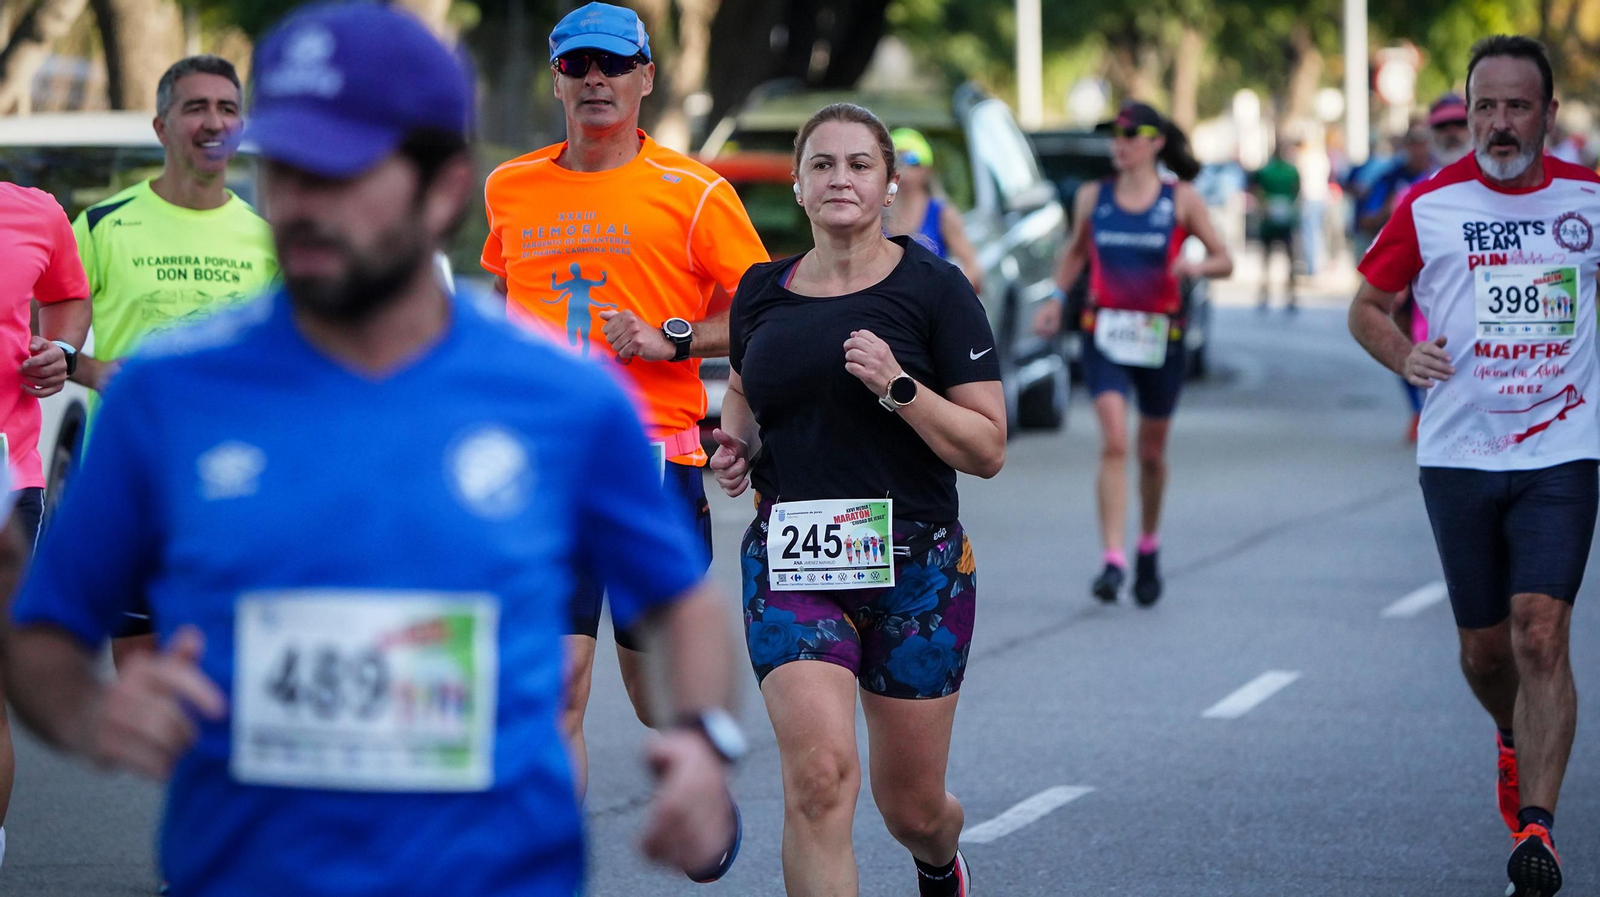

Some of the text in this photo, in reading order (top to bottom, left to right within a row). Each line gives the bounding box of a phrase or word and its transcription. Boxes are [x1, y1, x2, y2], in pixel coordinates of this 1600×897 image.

[557, 211, 596, 221] XXXIII
[522, 223, 631, 239] MEMORIAL
[1462, 220, 1546, 236] SPORTS
[522, 236, 631, 250] SARGENTO DE INFANTERIA
[1464, 232, 1522, 252] TEAM
[522, 251, 530, 259] DE
[532, 249, 562, 257] MARINA
[565, 246, 606, 254] CARMONA
[132, 256, 253, 270] VI CARRERA POPULAR
[157, 268, 188, 281] DON
[1488, 286, 1540, 314] 398
[1474, 339, 1571, 360] MAPFRE
[1498, 384, 1544, 395] JEREZ
[781, 524, 843, 559] 245
